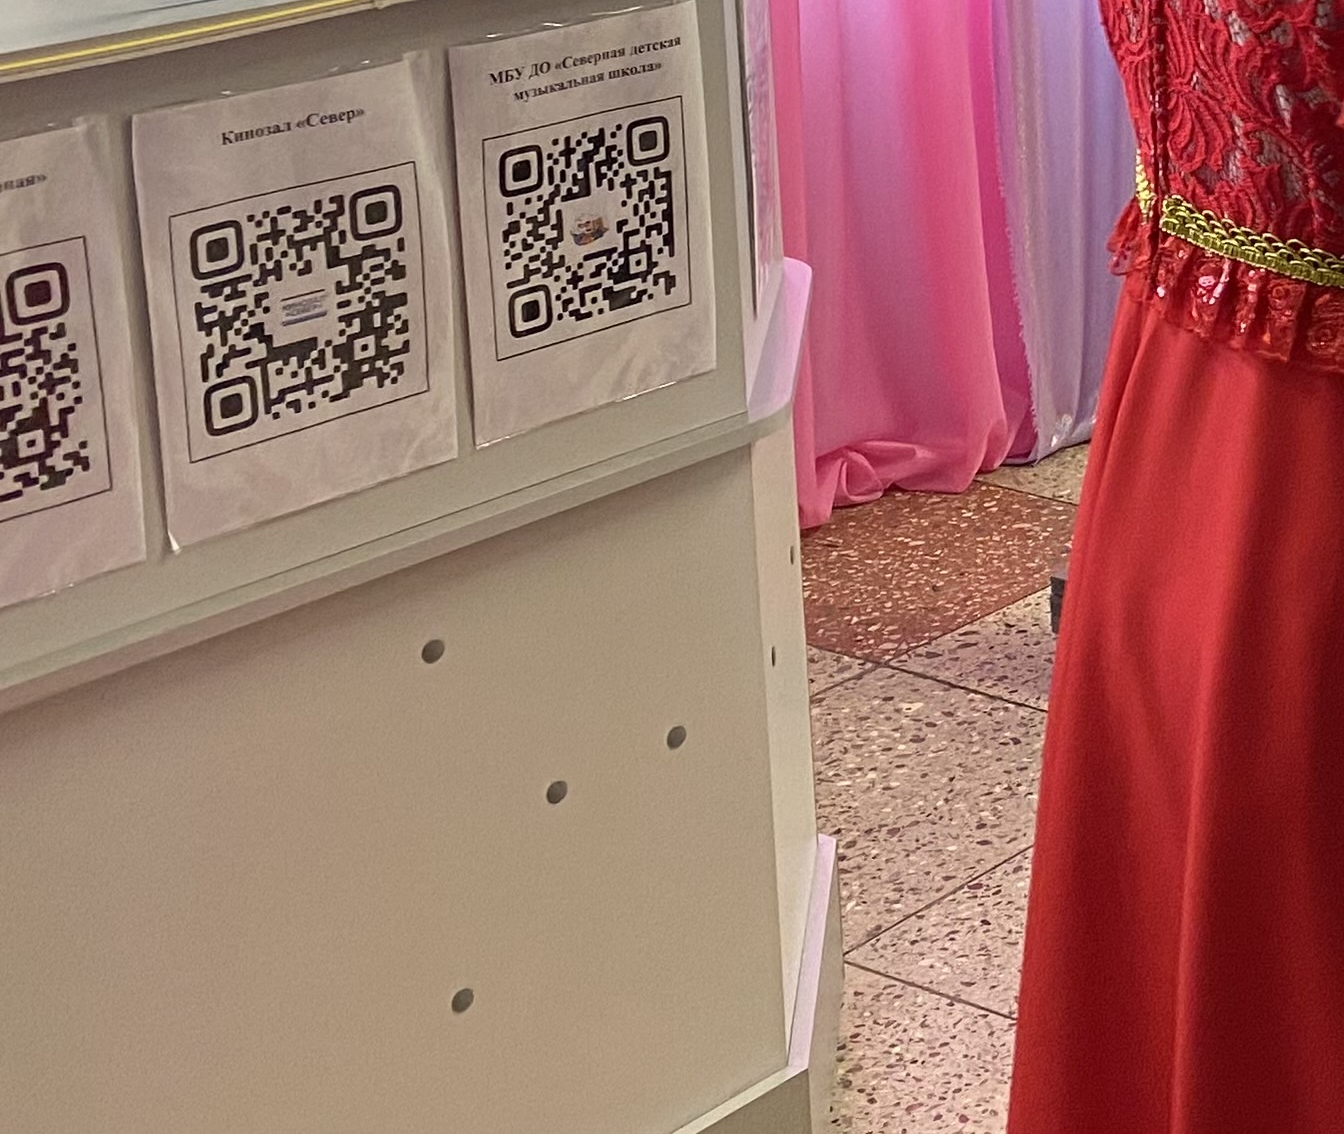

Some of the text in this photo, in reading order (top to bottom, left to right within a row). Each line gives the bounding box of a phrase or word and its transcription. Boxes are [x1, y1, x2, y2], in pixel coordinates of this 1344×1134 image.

[489, 36, 682, 86] МБУ ДО «Северная детская
[513, 61, 662, 102] музыкальная школа»
[221, 108, 365, 145] Кинозал «Север»
